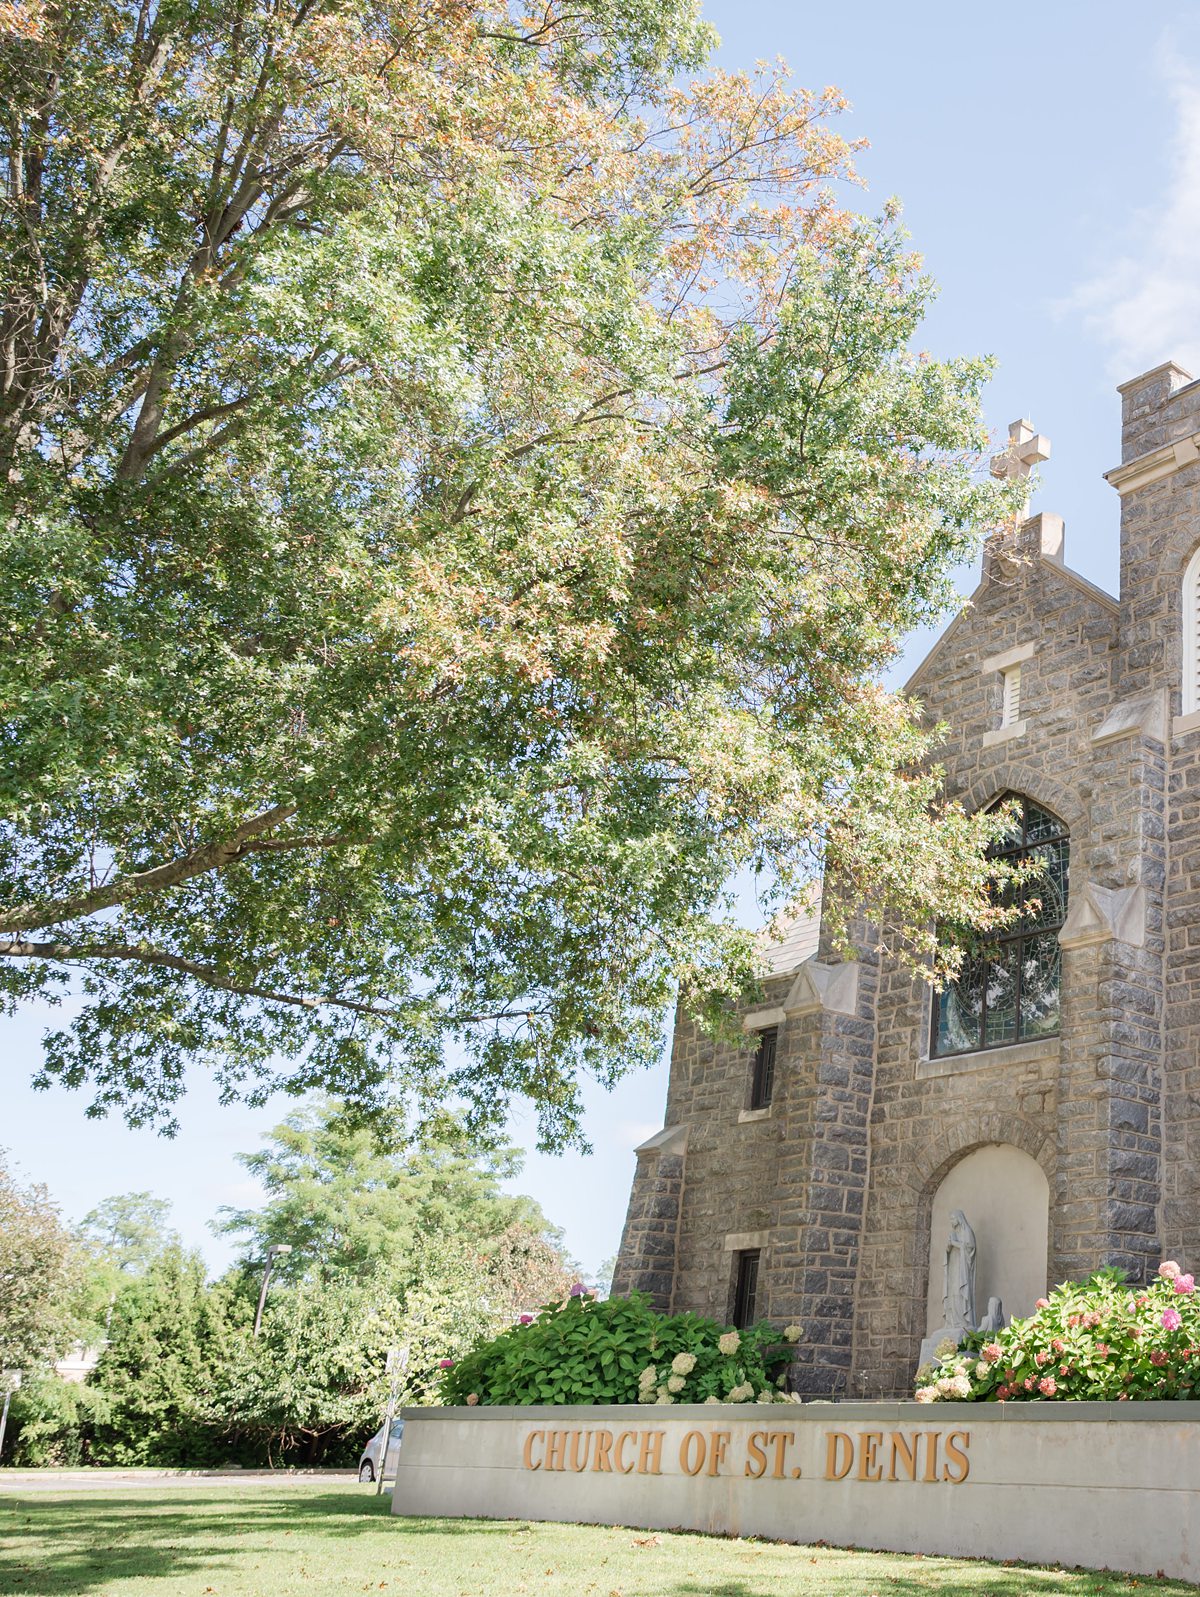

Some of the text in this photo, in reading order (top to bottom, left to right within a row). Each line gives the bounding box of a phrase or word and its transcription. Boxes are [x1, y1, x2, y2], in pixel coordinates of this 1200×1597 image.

[523, 1430, 970, 1484] CHURCH OF ST. DENIS
